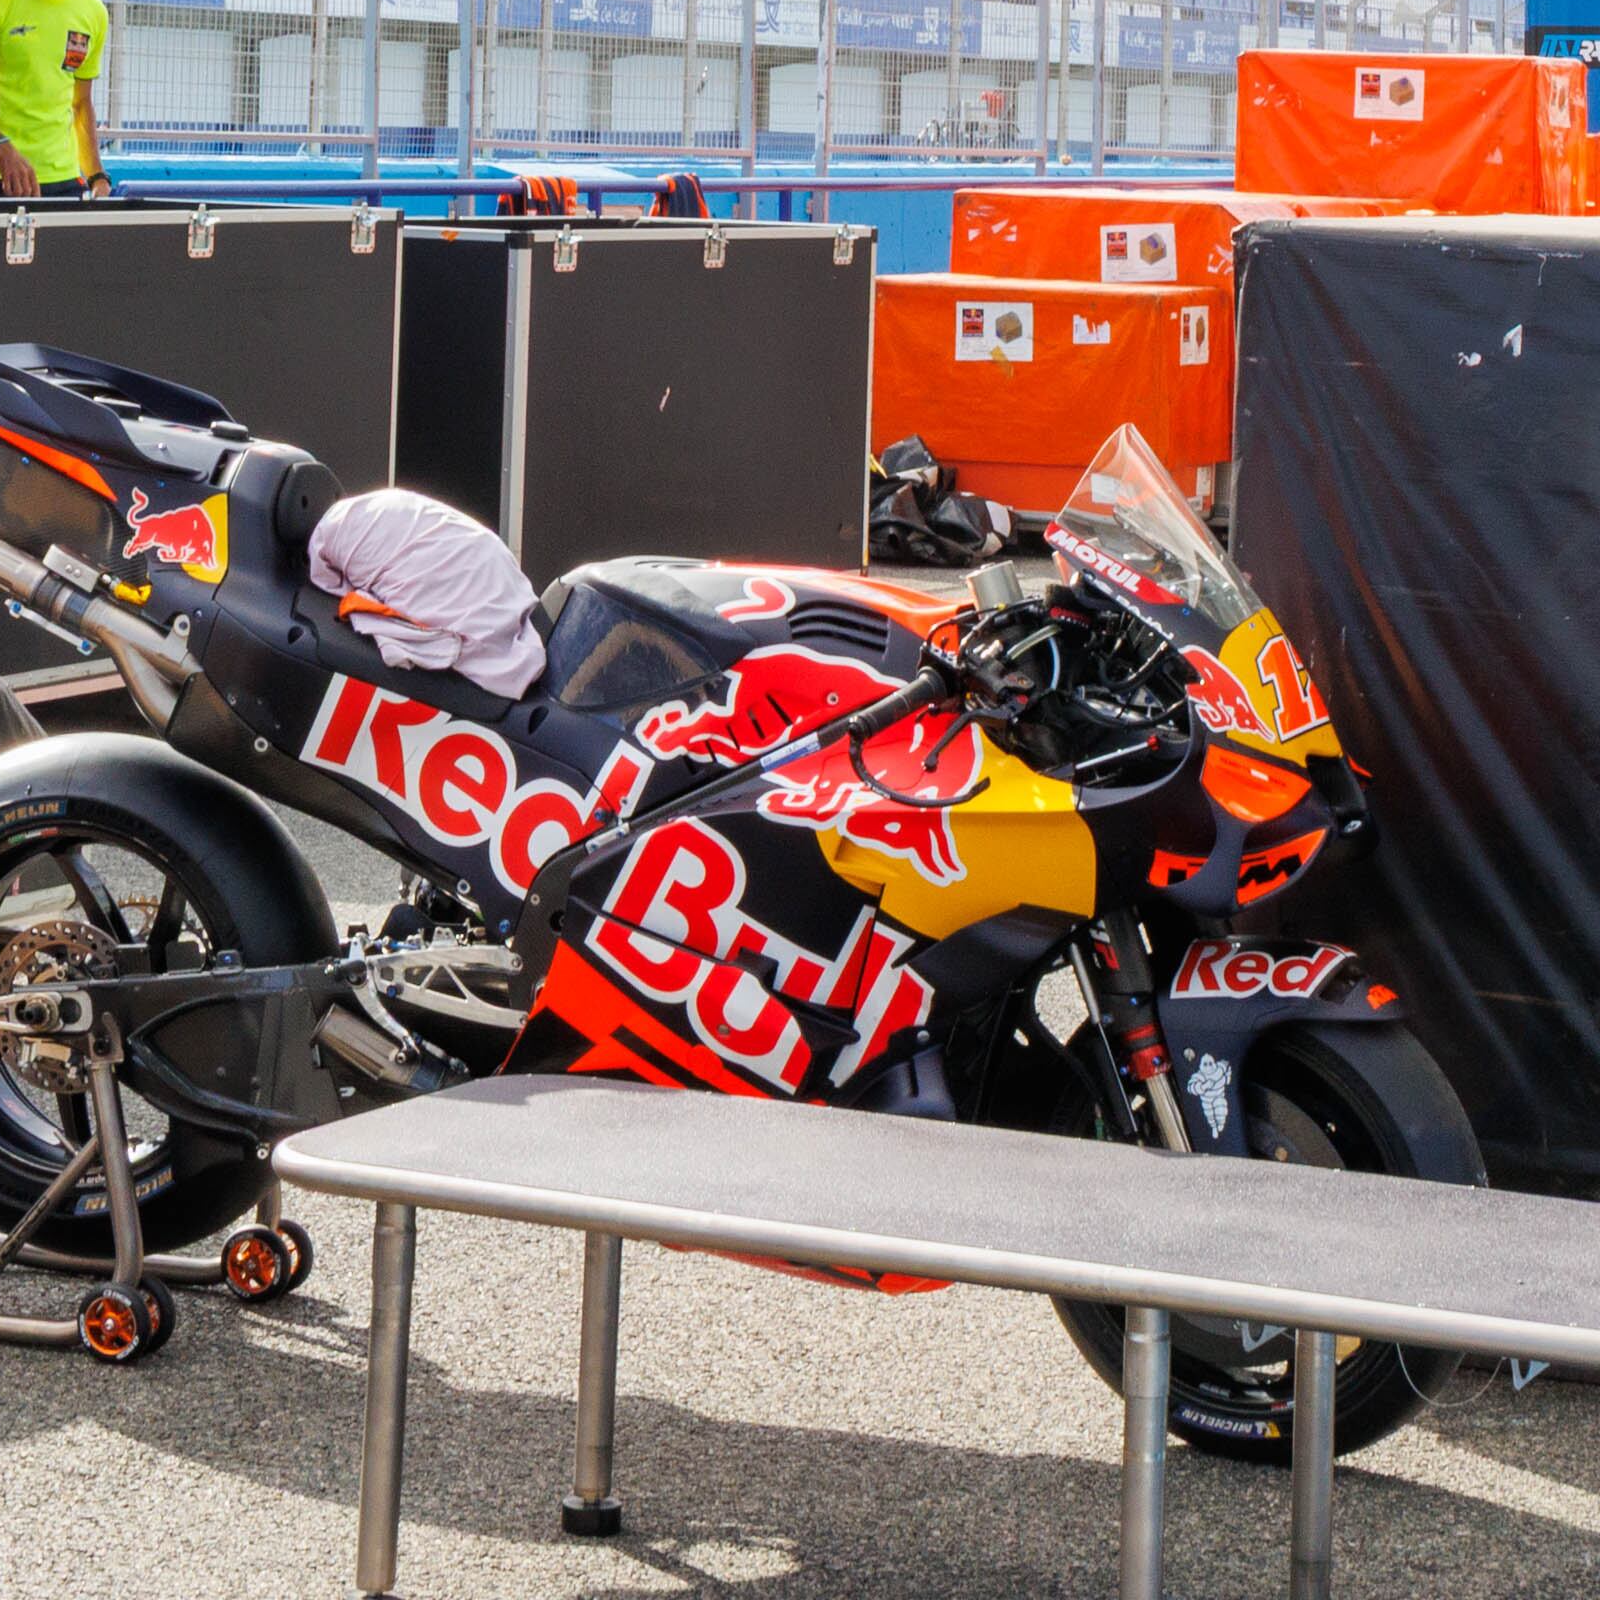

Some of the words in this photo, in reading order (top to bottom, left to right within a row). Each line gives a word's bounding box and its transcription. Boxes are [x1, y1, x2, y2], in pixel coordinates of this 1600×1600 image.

[1050, 529, 1144, 593] MOTUL
[300, 671, 655, 901] Red
[585, 815, 936, 1097] Bull
[1169, 938, 1353, 1001] Red
[1181, 1408, 1253, 1434] MICHELIN
